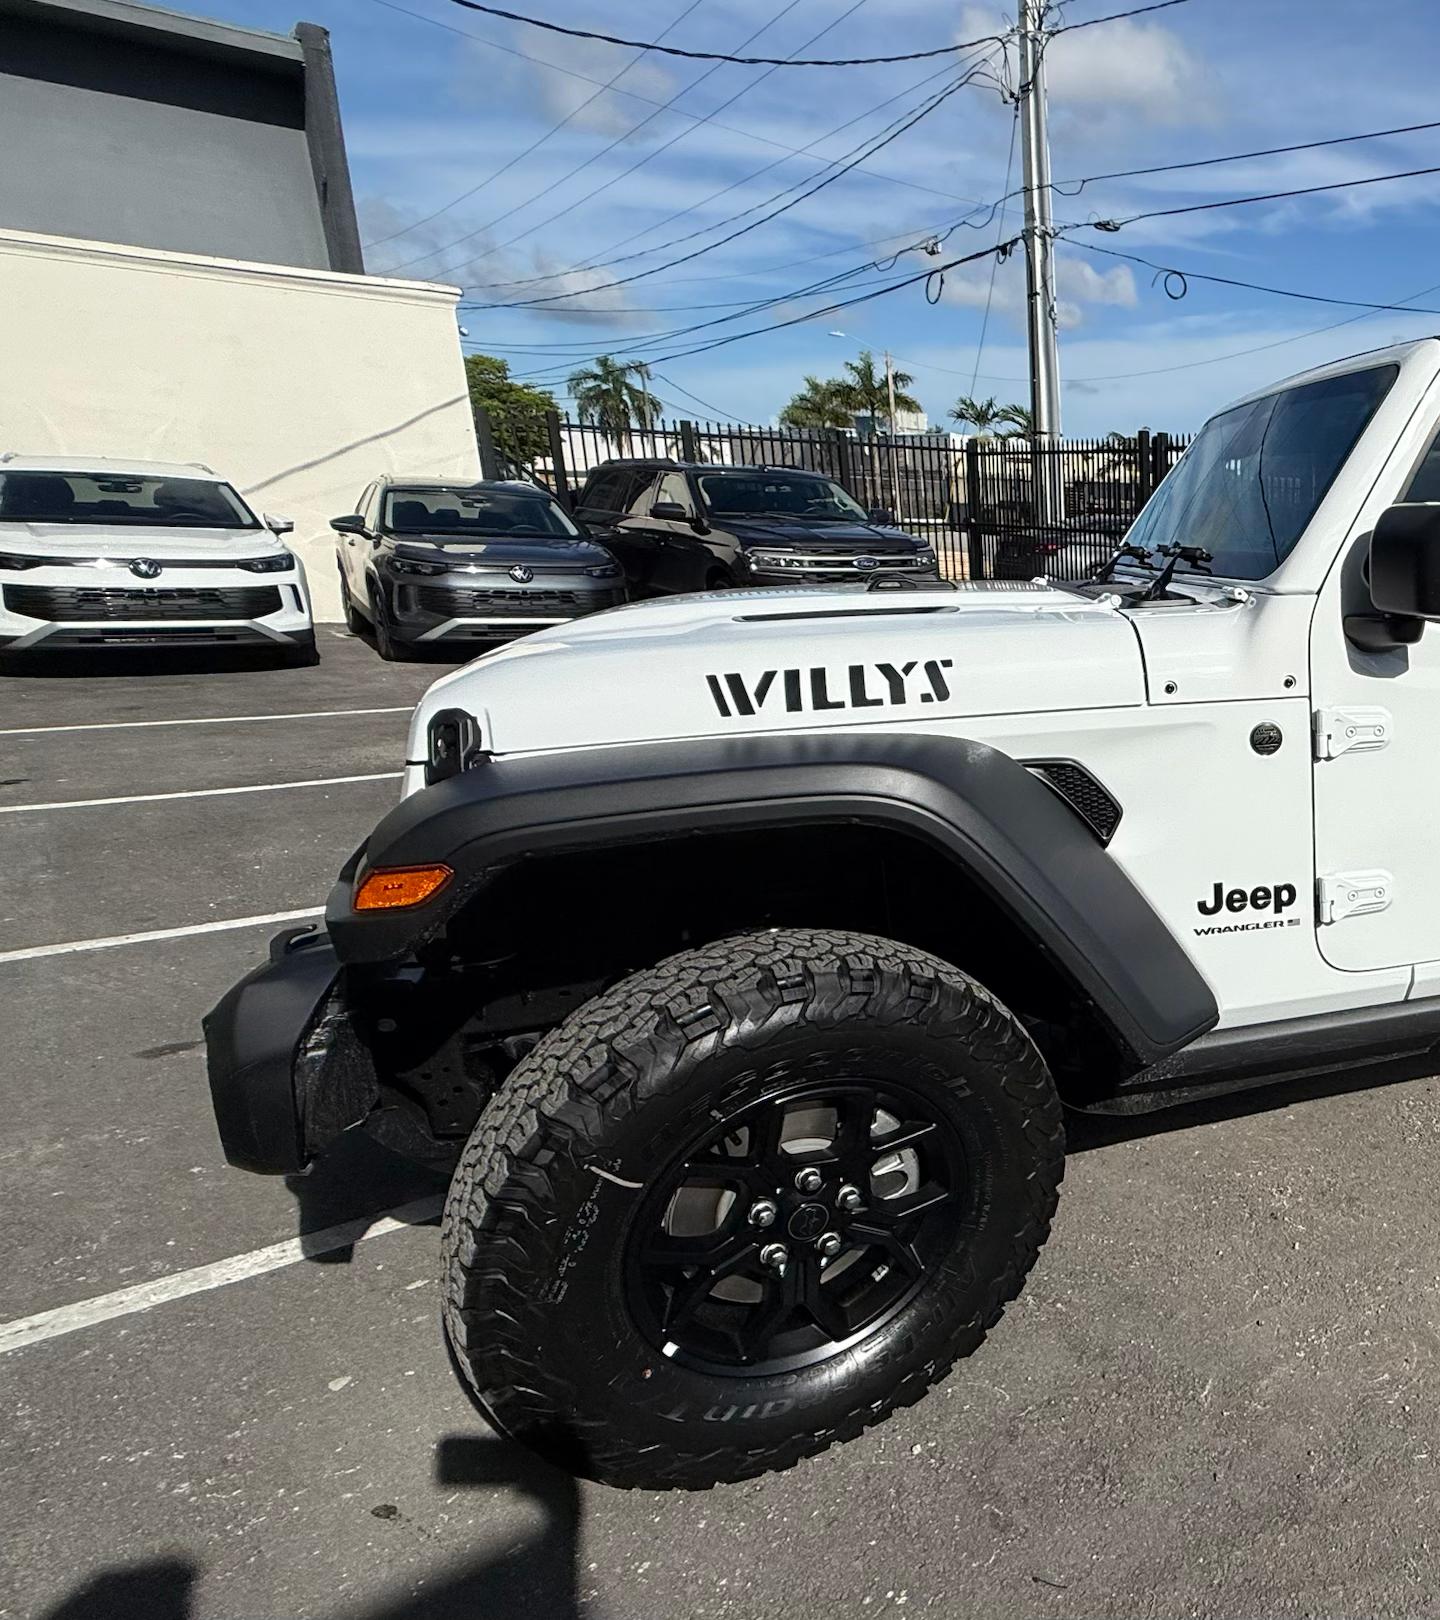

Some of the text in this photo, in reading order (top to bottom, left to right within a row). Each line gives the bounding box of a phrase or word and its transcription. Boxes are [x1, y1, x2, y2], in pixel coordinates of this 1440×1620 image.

[705, 659, 953, 717] WILLYS
[1197, 882, 1297, 916] Jeep
[1193, 920, 1285, 936] WRANGLER
